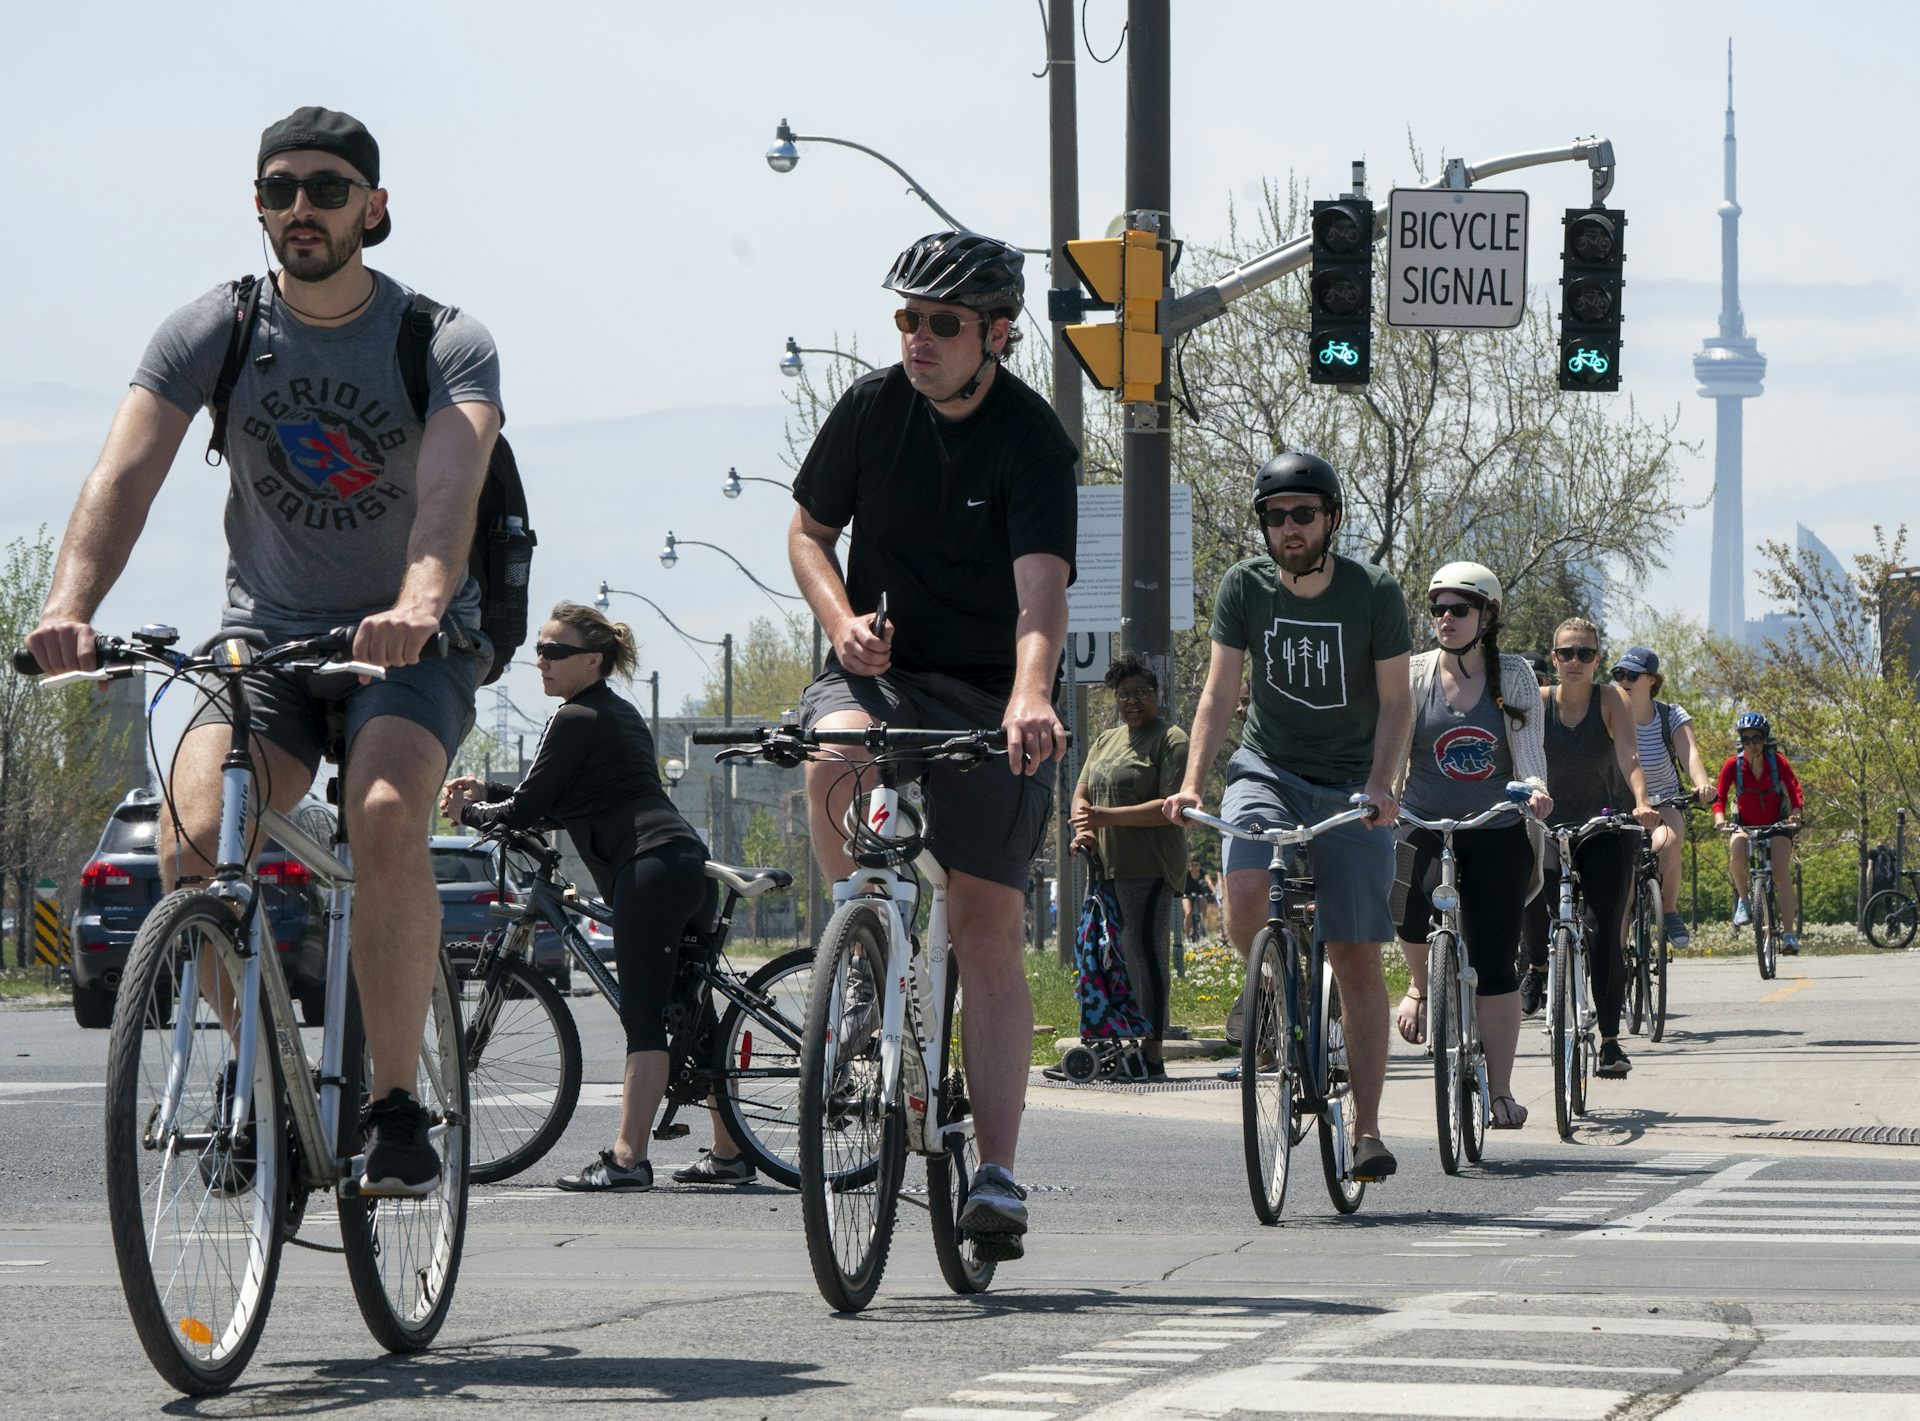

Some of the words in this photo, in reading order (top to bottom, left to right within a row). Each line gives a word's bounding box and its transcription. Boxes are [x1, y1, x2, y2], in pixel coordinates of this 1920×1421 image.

[1400, 211, 1520, 251] BICYCLE
[1402, 266, 1513, 306] SIGNAL
[243, 377, 407, 450] SERIOUS
[253, 475, 408, 530] SQUASH
